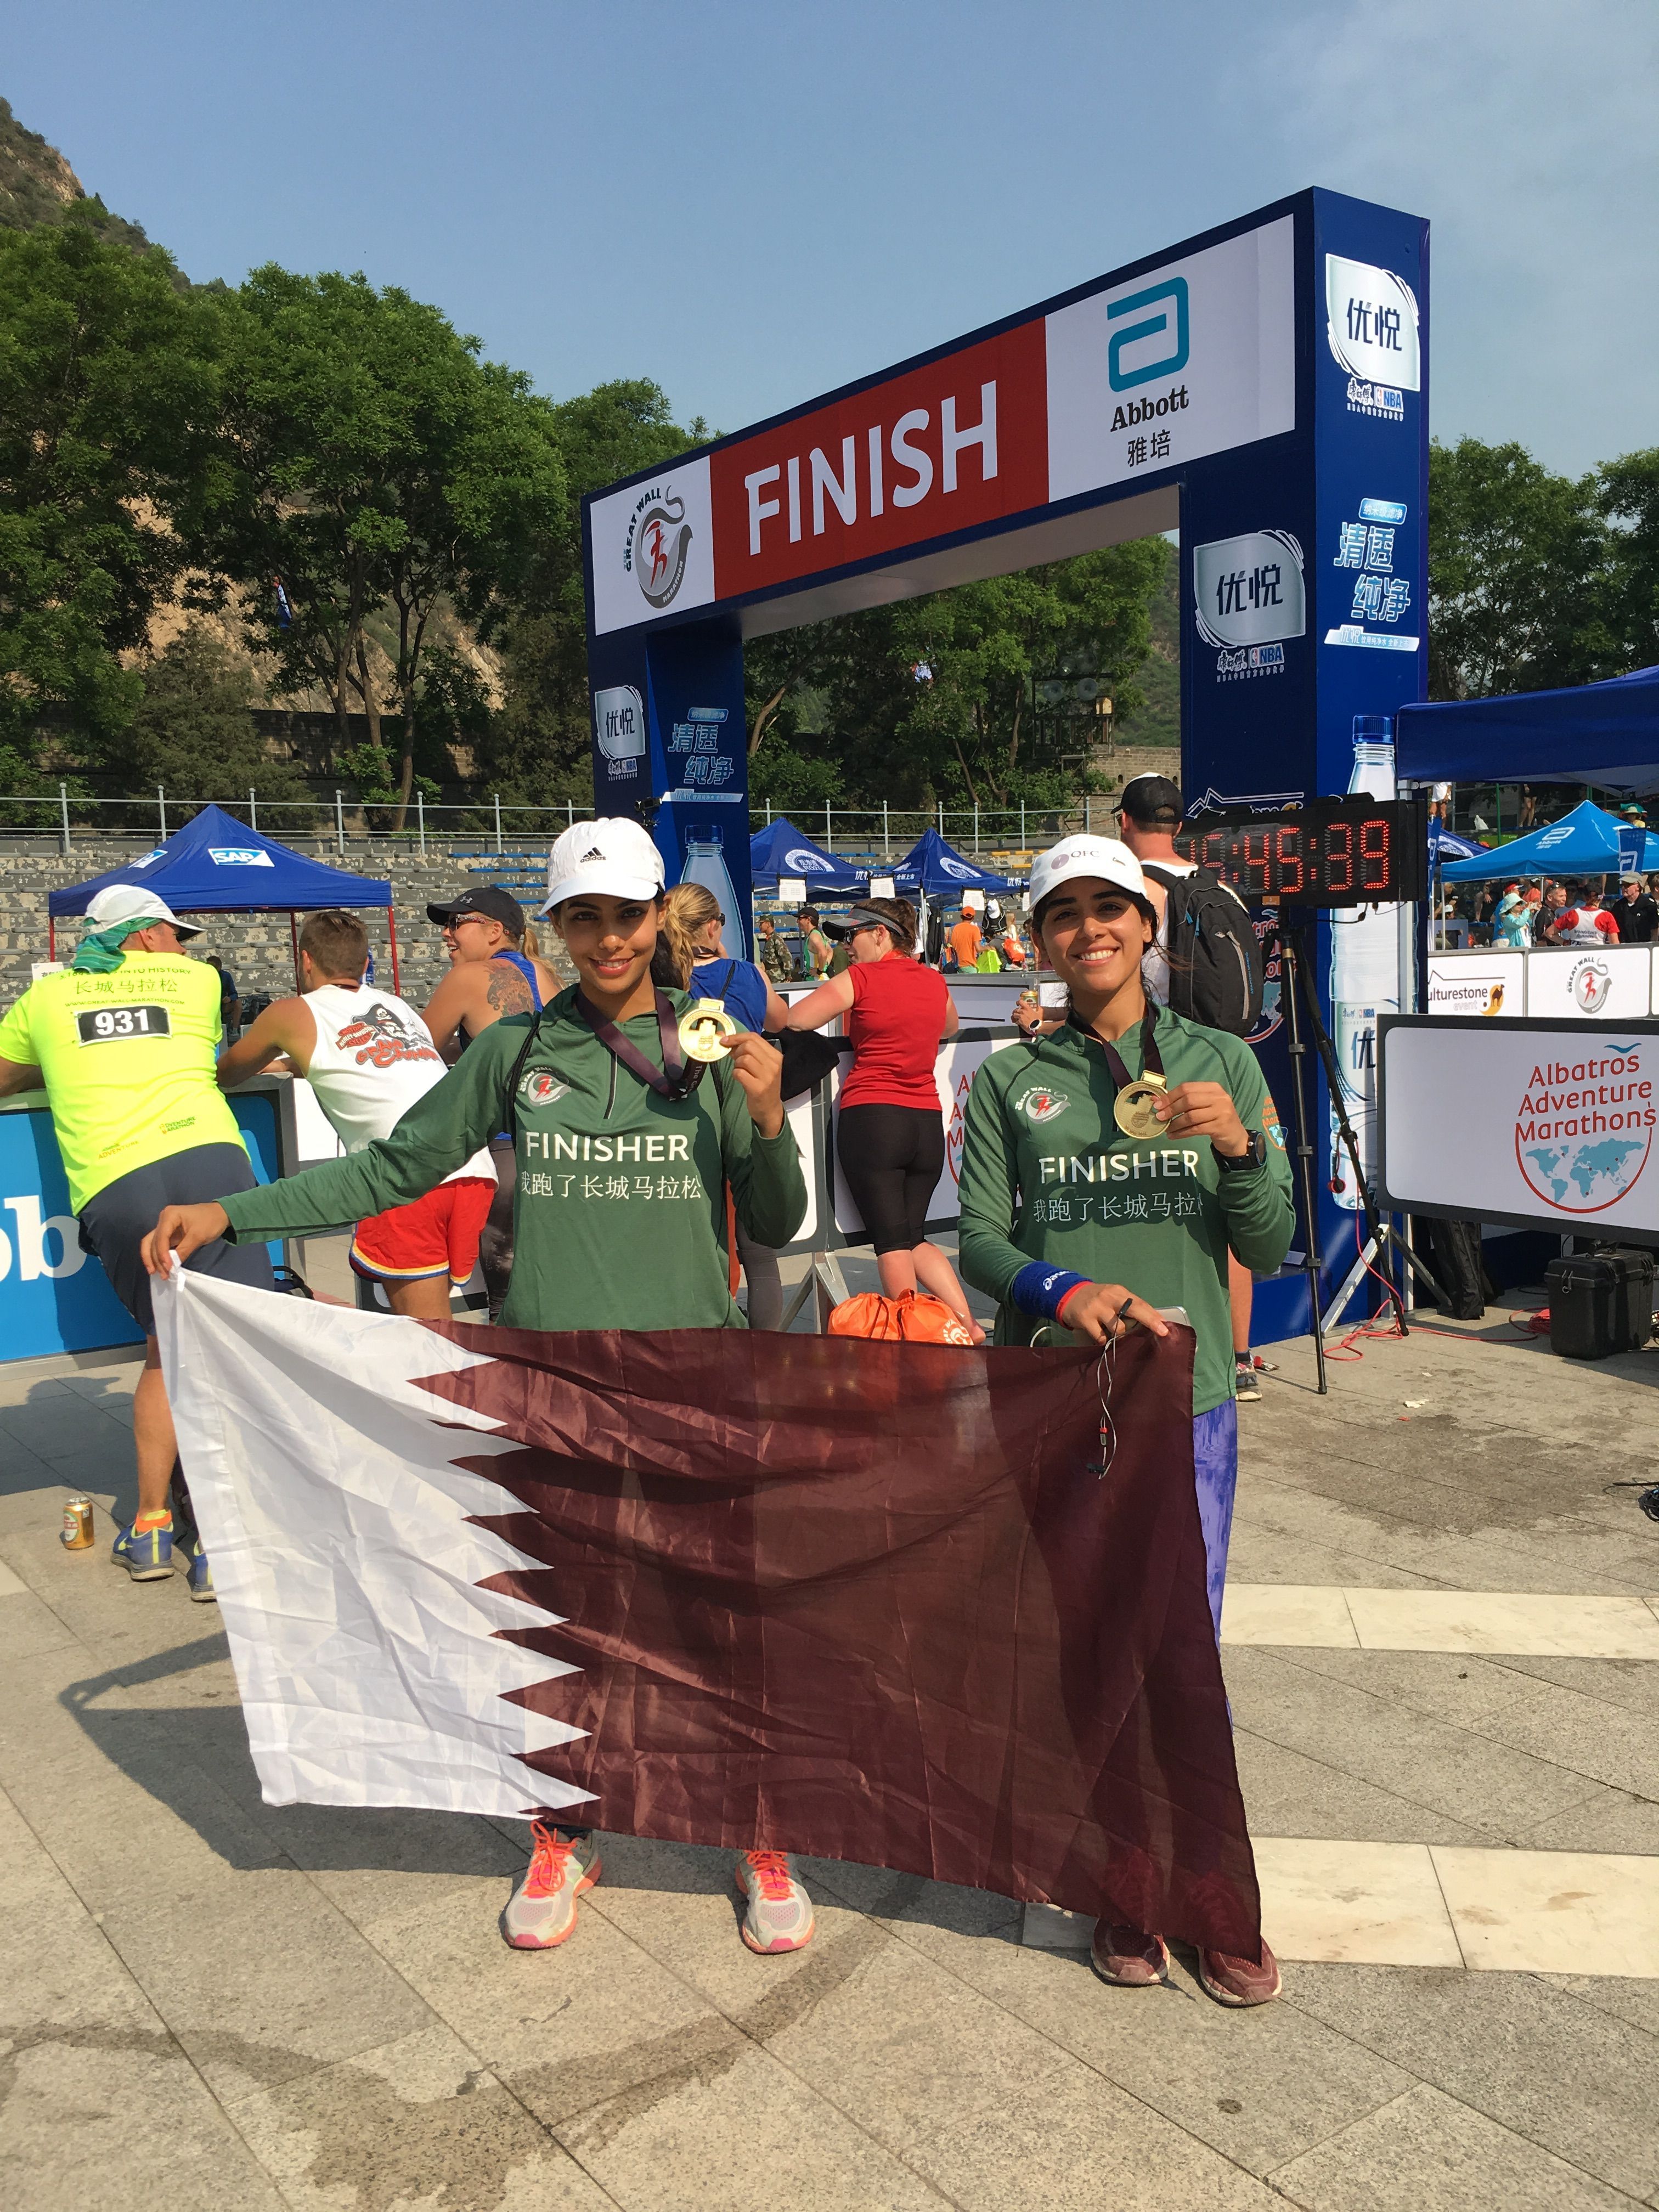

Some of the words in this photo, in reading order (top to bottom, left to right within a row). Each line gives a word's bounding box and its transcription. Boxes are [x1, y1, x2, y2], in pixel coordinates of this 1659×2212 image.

[1347, 298, 1402, 351] 优悦
[1110, 385, 1189, 432] Abbott
[1383, 390, 1402, 410] NBA
[1127, 429, 1171, 467] 雅培
[744, 380, 997, 556] FINISH
[625, 514, 637, 572] GREAT
[636, 488, 662, 513] WALL
[1333, 522, 1395, 573] 清透
[663, 560, 684, 603] MARATHON
[1216, 563, 1283, 616] 优悦
[1351, 574, 1410, 622] 纯净
[1260, 646, 1283, 664] NBA
[606, 707, 635, 738] 优悦
[668, 724, 719, 754] 清透
[684, 755, 734, 785] 纯净
[214, 852, 253, 862] SAP
[75, 978, 178, 995] 长城马拉松
[1568, 966, 1578, 993] GREAT
[1578, 957, 1595, 966] WALL
[1428, 987, 1488, 1001] ulturestone
[1453, 1000, 1478, 1011] event
[94, 1008, 150, 1036] 931
[694, 1065, 703, 1080] The
[1528, 1054, 1640, 1088] Albatros
[1518, 1080, 1652, 1116] Adventure
[1515, 1108, 1657, 1142] Marathons
[526, 1132, 690, 1162] FINISHER
[1039, 1150, 1199, 1184] FINISHER
[521, 1170, 701, 1200] 我跑了长城马拉松
